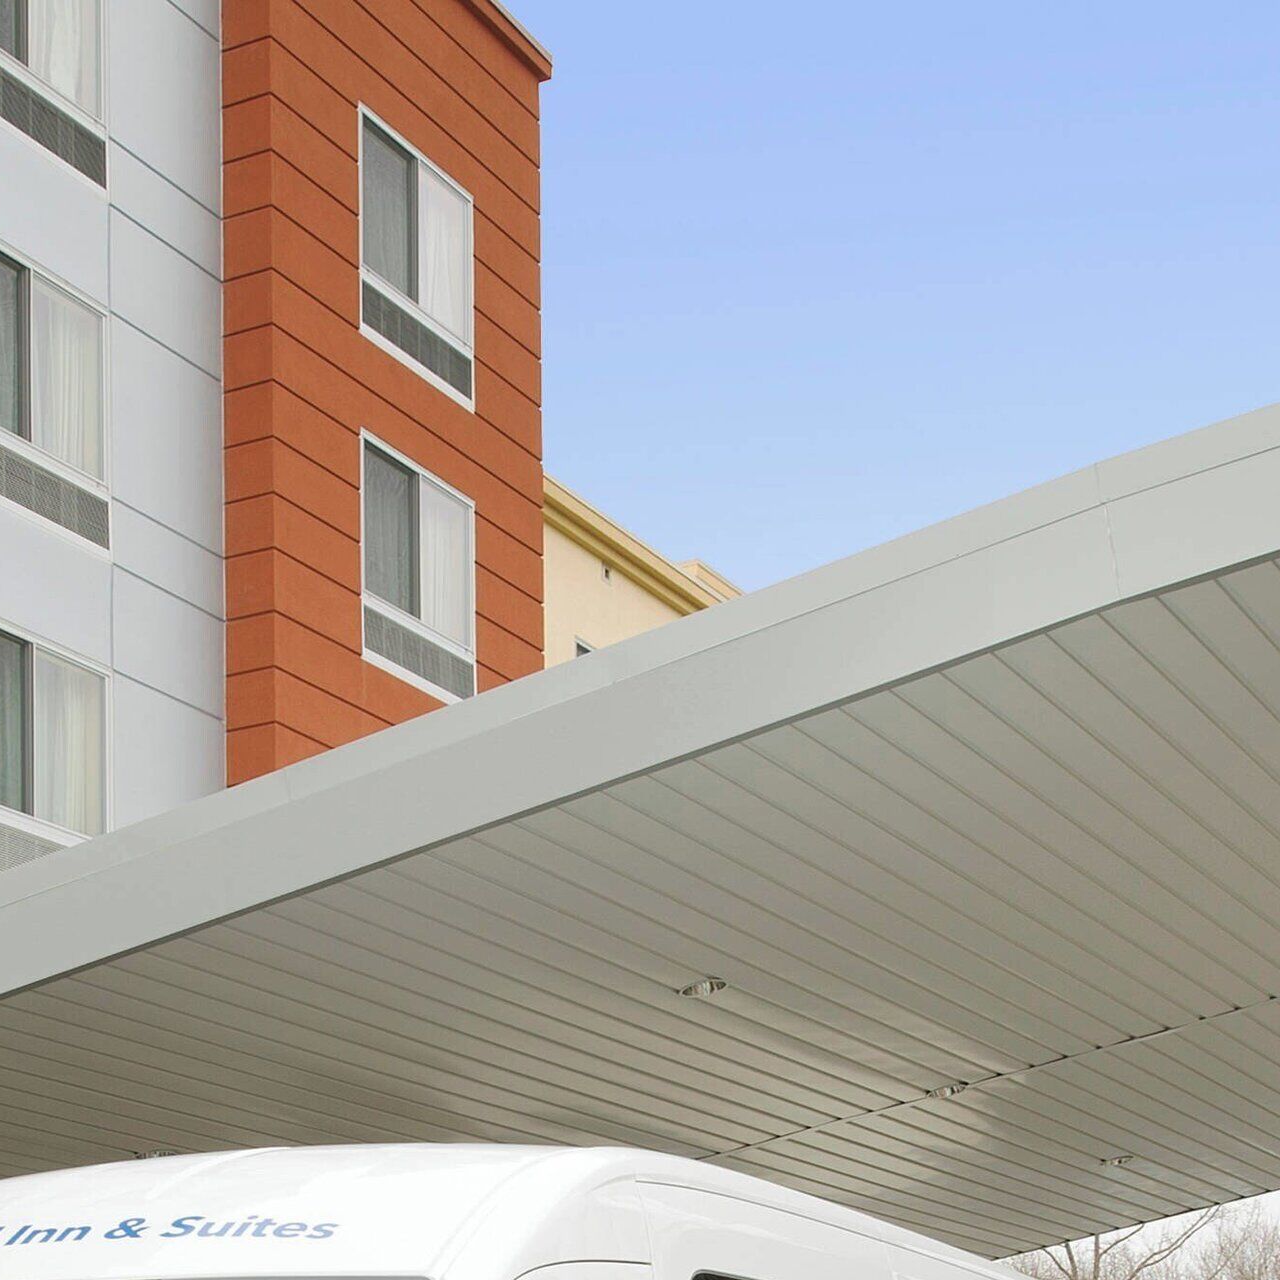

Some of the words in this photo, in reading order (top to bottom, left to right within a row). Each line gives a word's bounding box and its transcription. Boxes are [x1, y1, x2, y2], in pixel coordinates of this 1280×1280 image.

[4, 1223, 91, 1246] Inn
[104, 1217, 151, 1240] &
[159, 1214, 340, 1240] Suites
